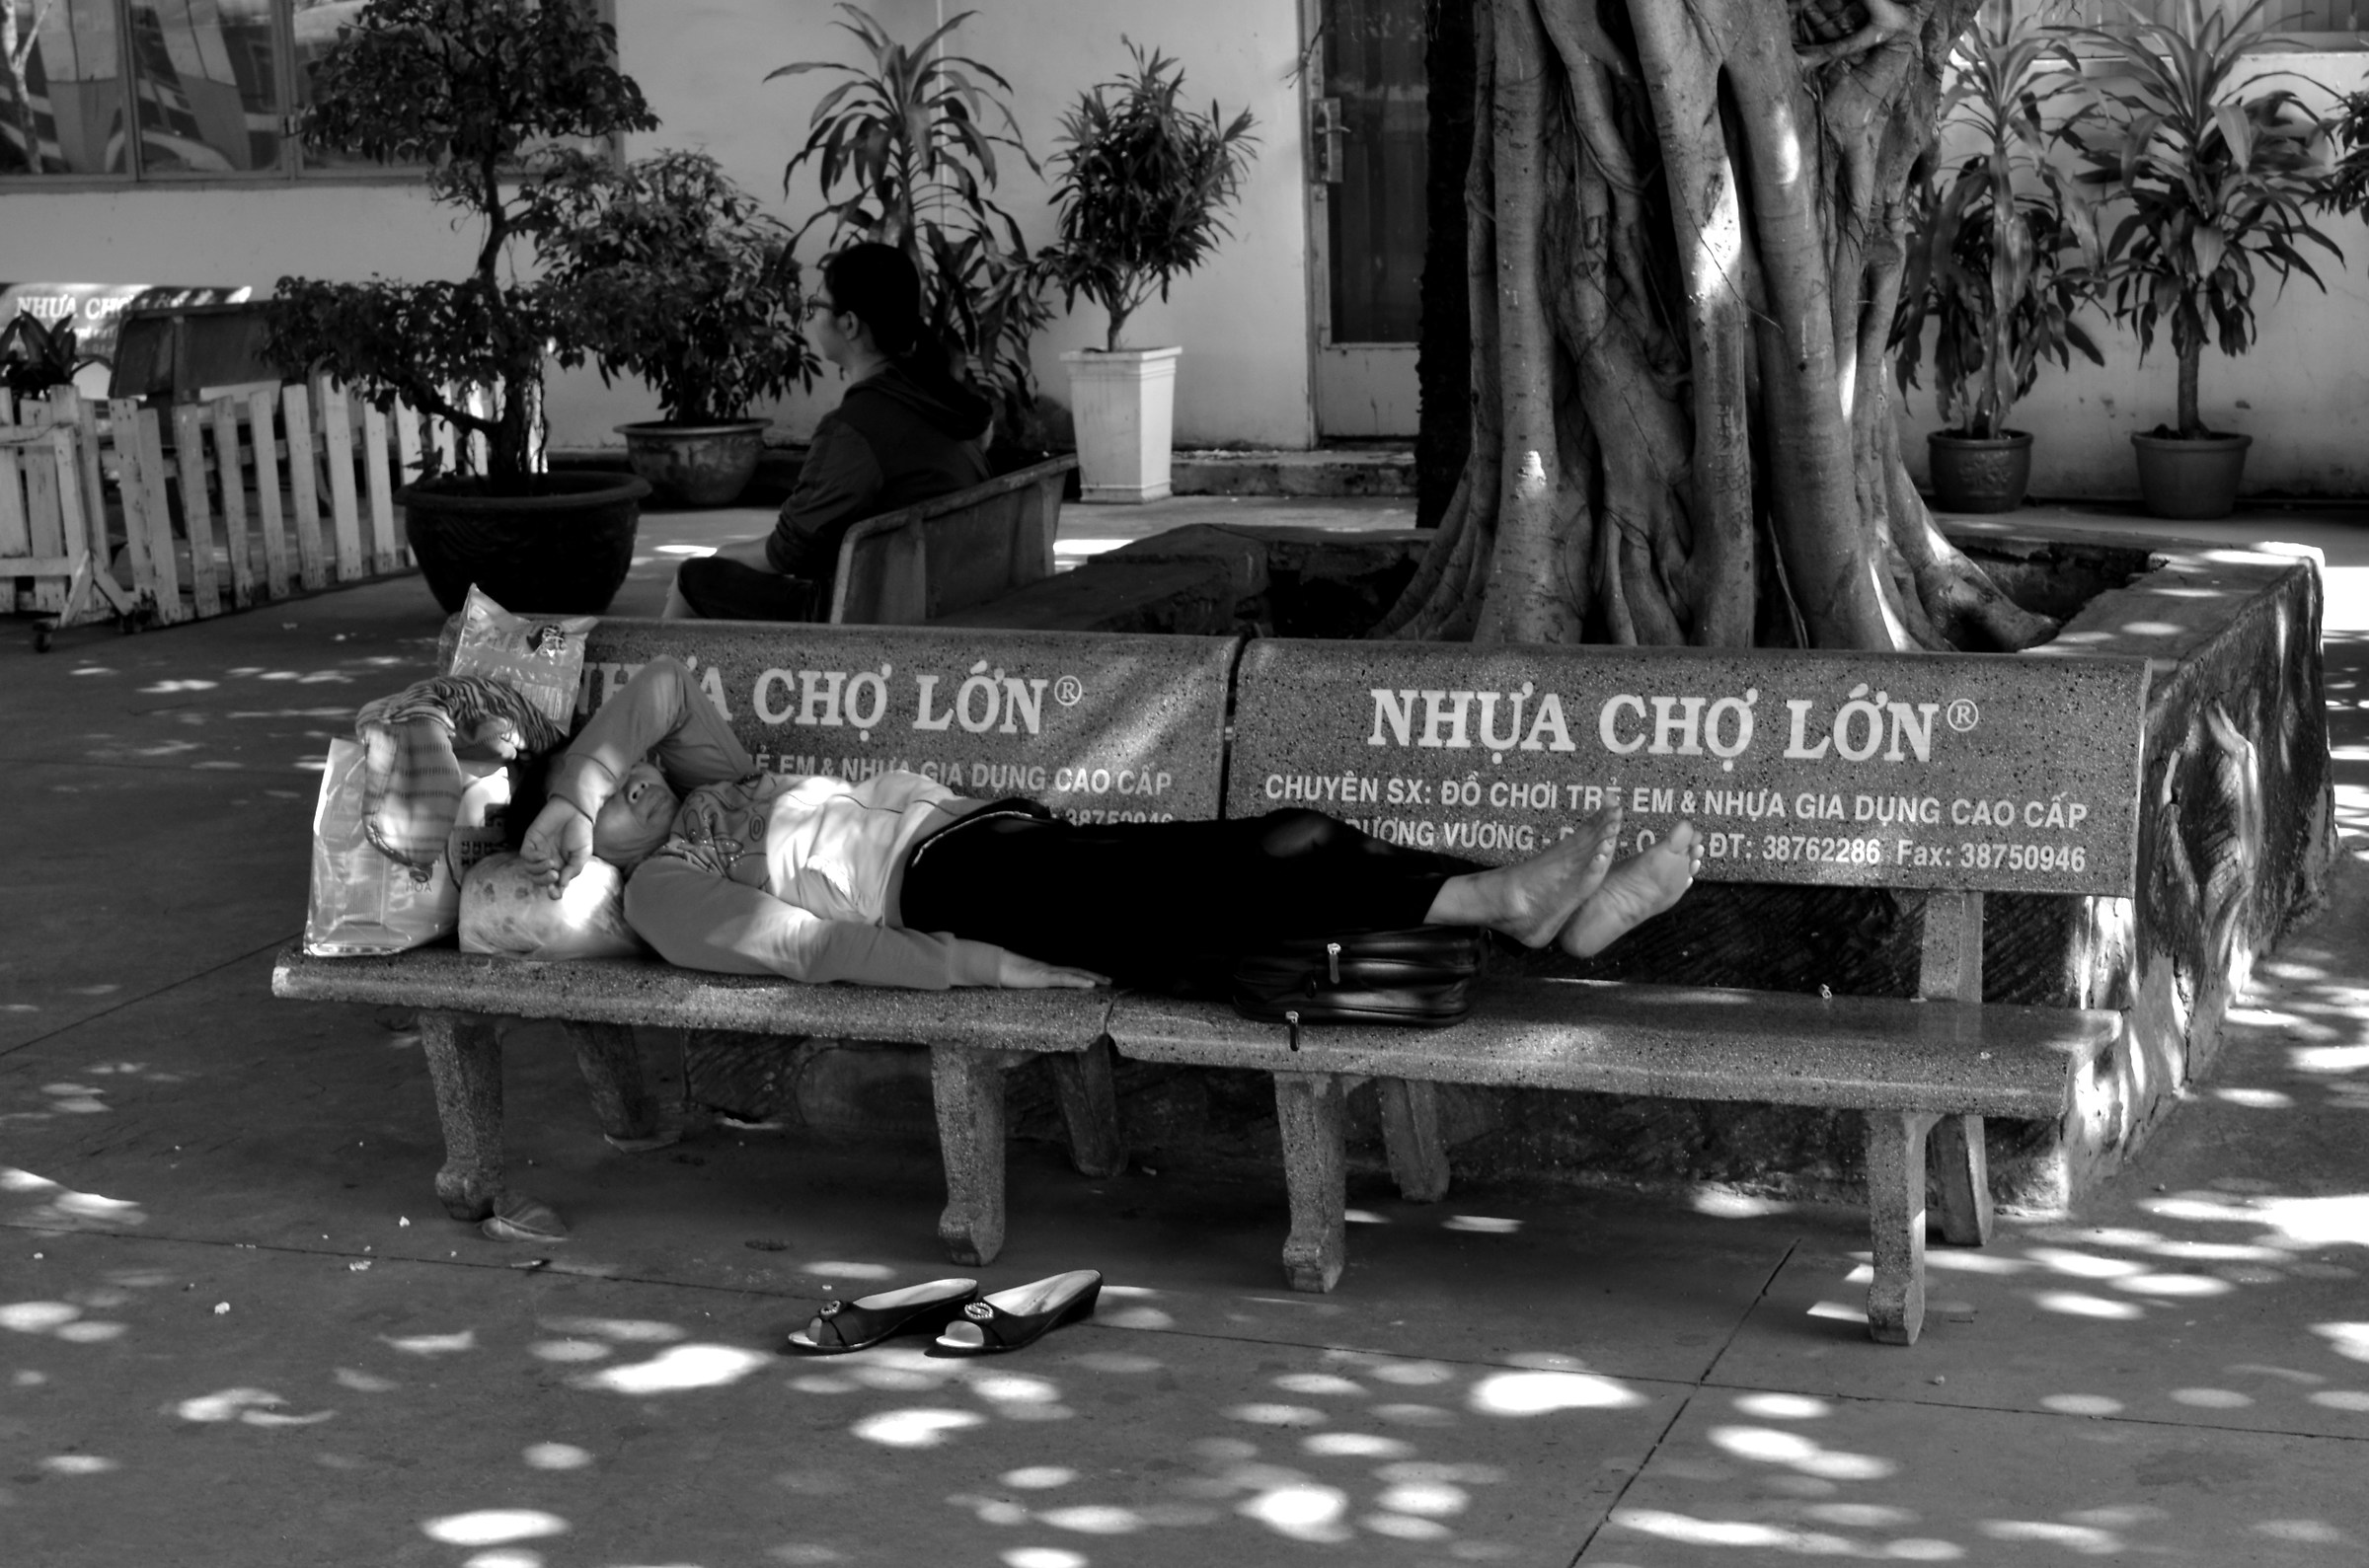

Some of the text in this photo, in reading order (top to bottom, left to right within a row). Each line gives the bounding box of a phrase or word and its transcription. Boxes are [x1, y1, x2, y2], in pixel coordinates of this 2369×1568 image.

[753, 663, 891, 742] CHỢ
[1367, 681, 1576, 765] NHỰA
[1598, 687, 1759, 772] CHỢ
[971, 762, 1046, 793] DỤNG
[1054, 767, 1111, 794] CAO
[1264, 770, 2088, 830] CHUYÊN SX: ĐỒ CHƠI TR EM & NHỰA GIA DỤNG CAO CẤP
[1443, 819, 1533, 851] VƯƠNG
[1709, 832, 1752, 859] ĐT:
[1762, 835, 1880, 864] 38762286
[1897, 840, 1952, 867] Fax:
[1959, 845, 2086, 872] 38750946
